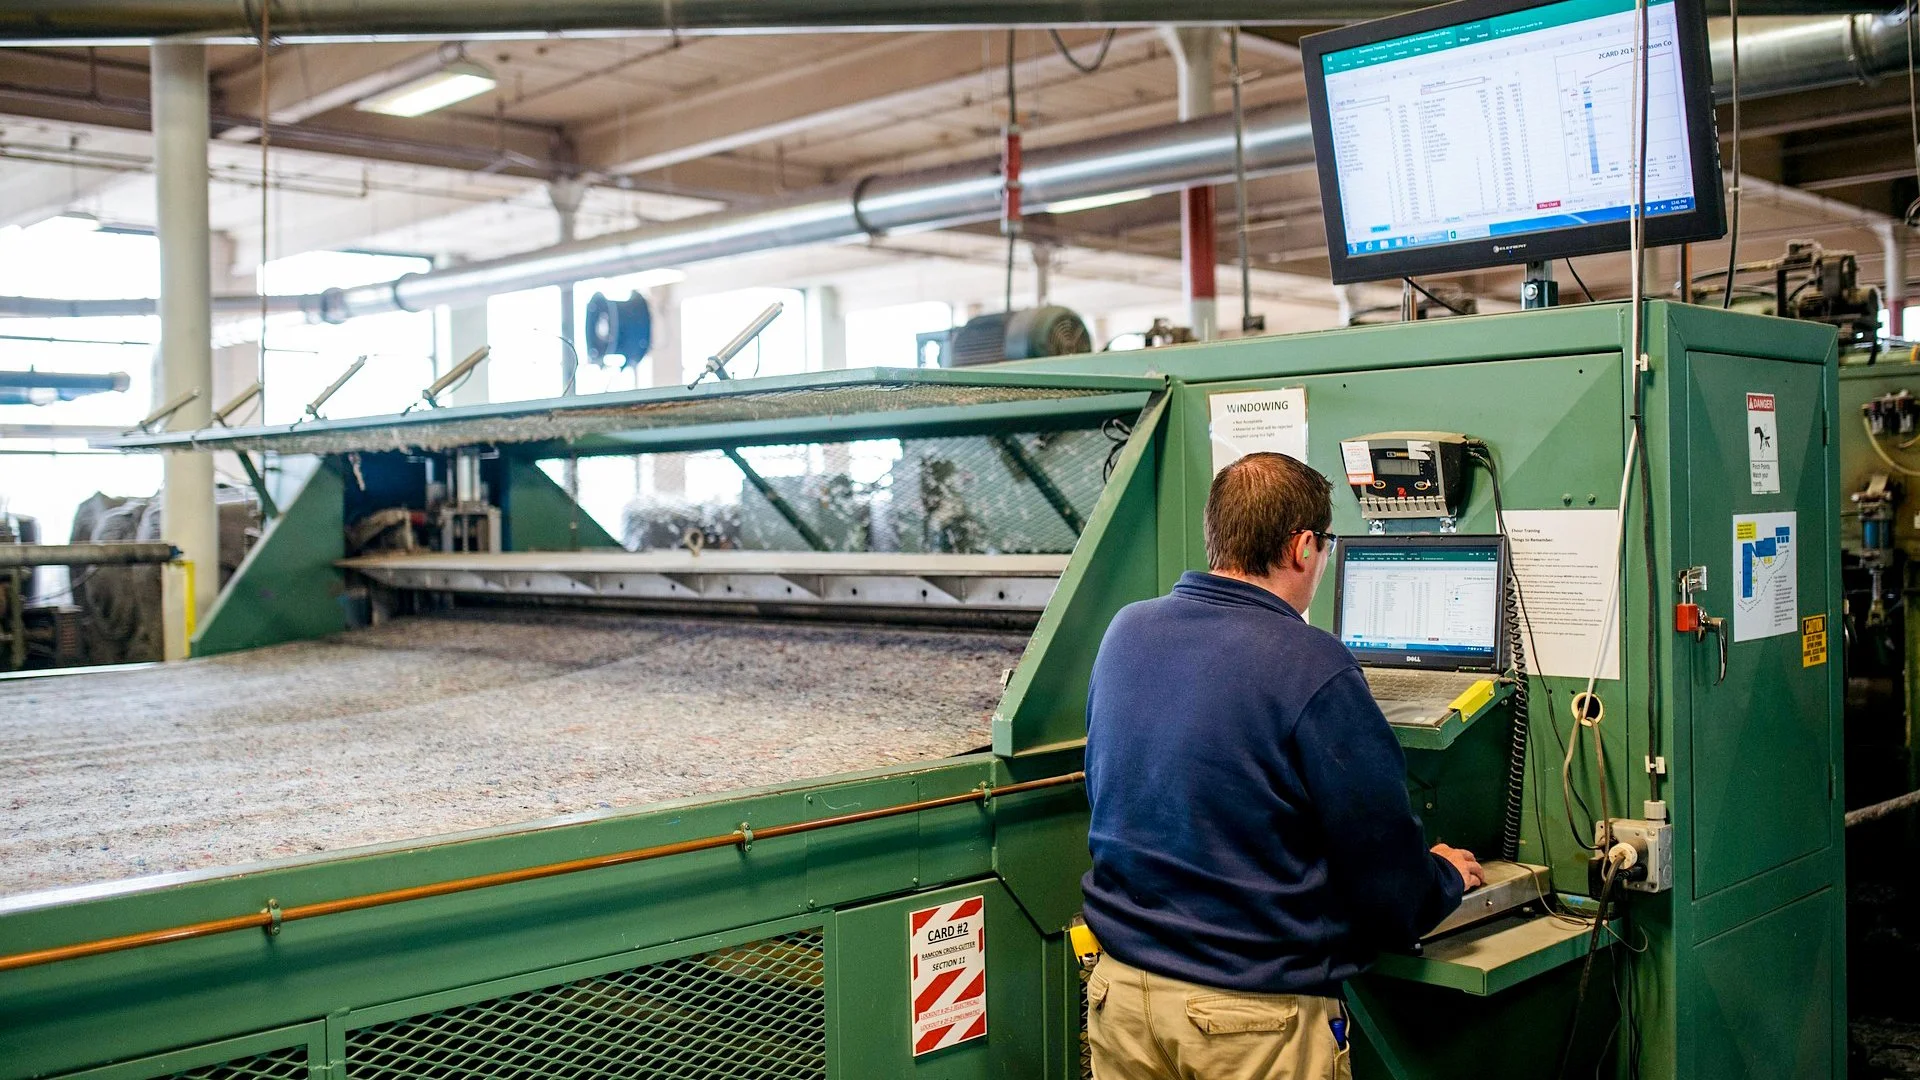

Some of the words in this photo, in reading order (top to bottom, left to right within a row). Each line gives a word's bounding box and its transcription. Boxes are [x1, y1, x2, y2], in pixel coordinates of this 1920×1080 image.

[1598, 49, 1619, 60] 2CARD
[1620, 47, 1630, 55] 2Q
[1226, 400, 1289, 413] WINDOWING
[1753, 399, 1774, 409] DANGER
[927, 925, 955, 942] CARD
[957, 921, 969, 935] #2
[921, 948, 943, 960] RAMCON
[943, 940, 976, 955] CROSS-CUTTER
[932, 958, 958, 972] SECTION
[958, 956, 966, 965] 11
